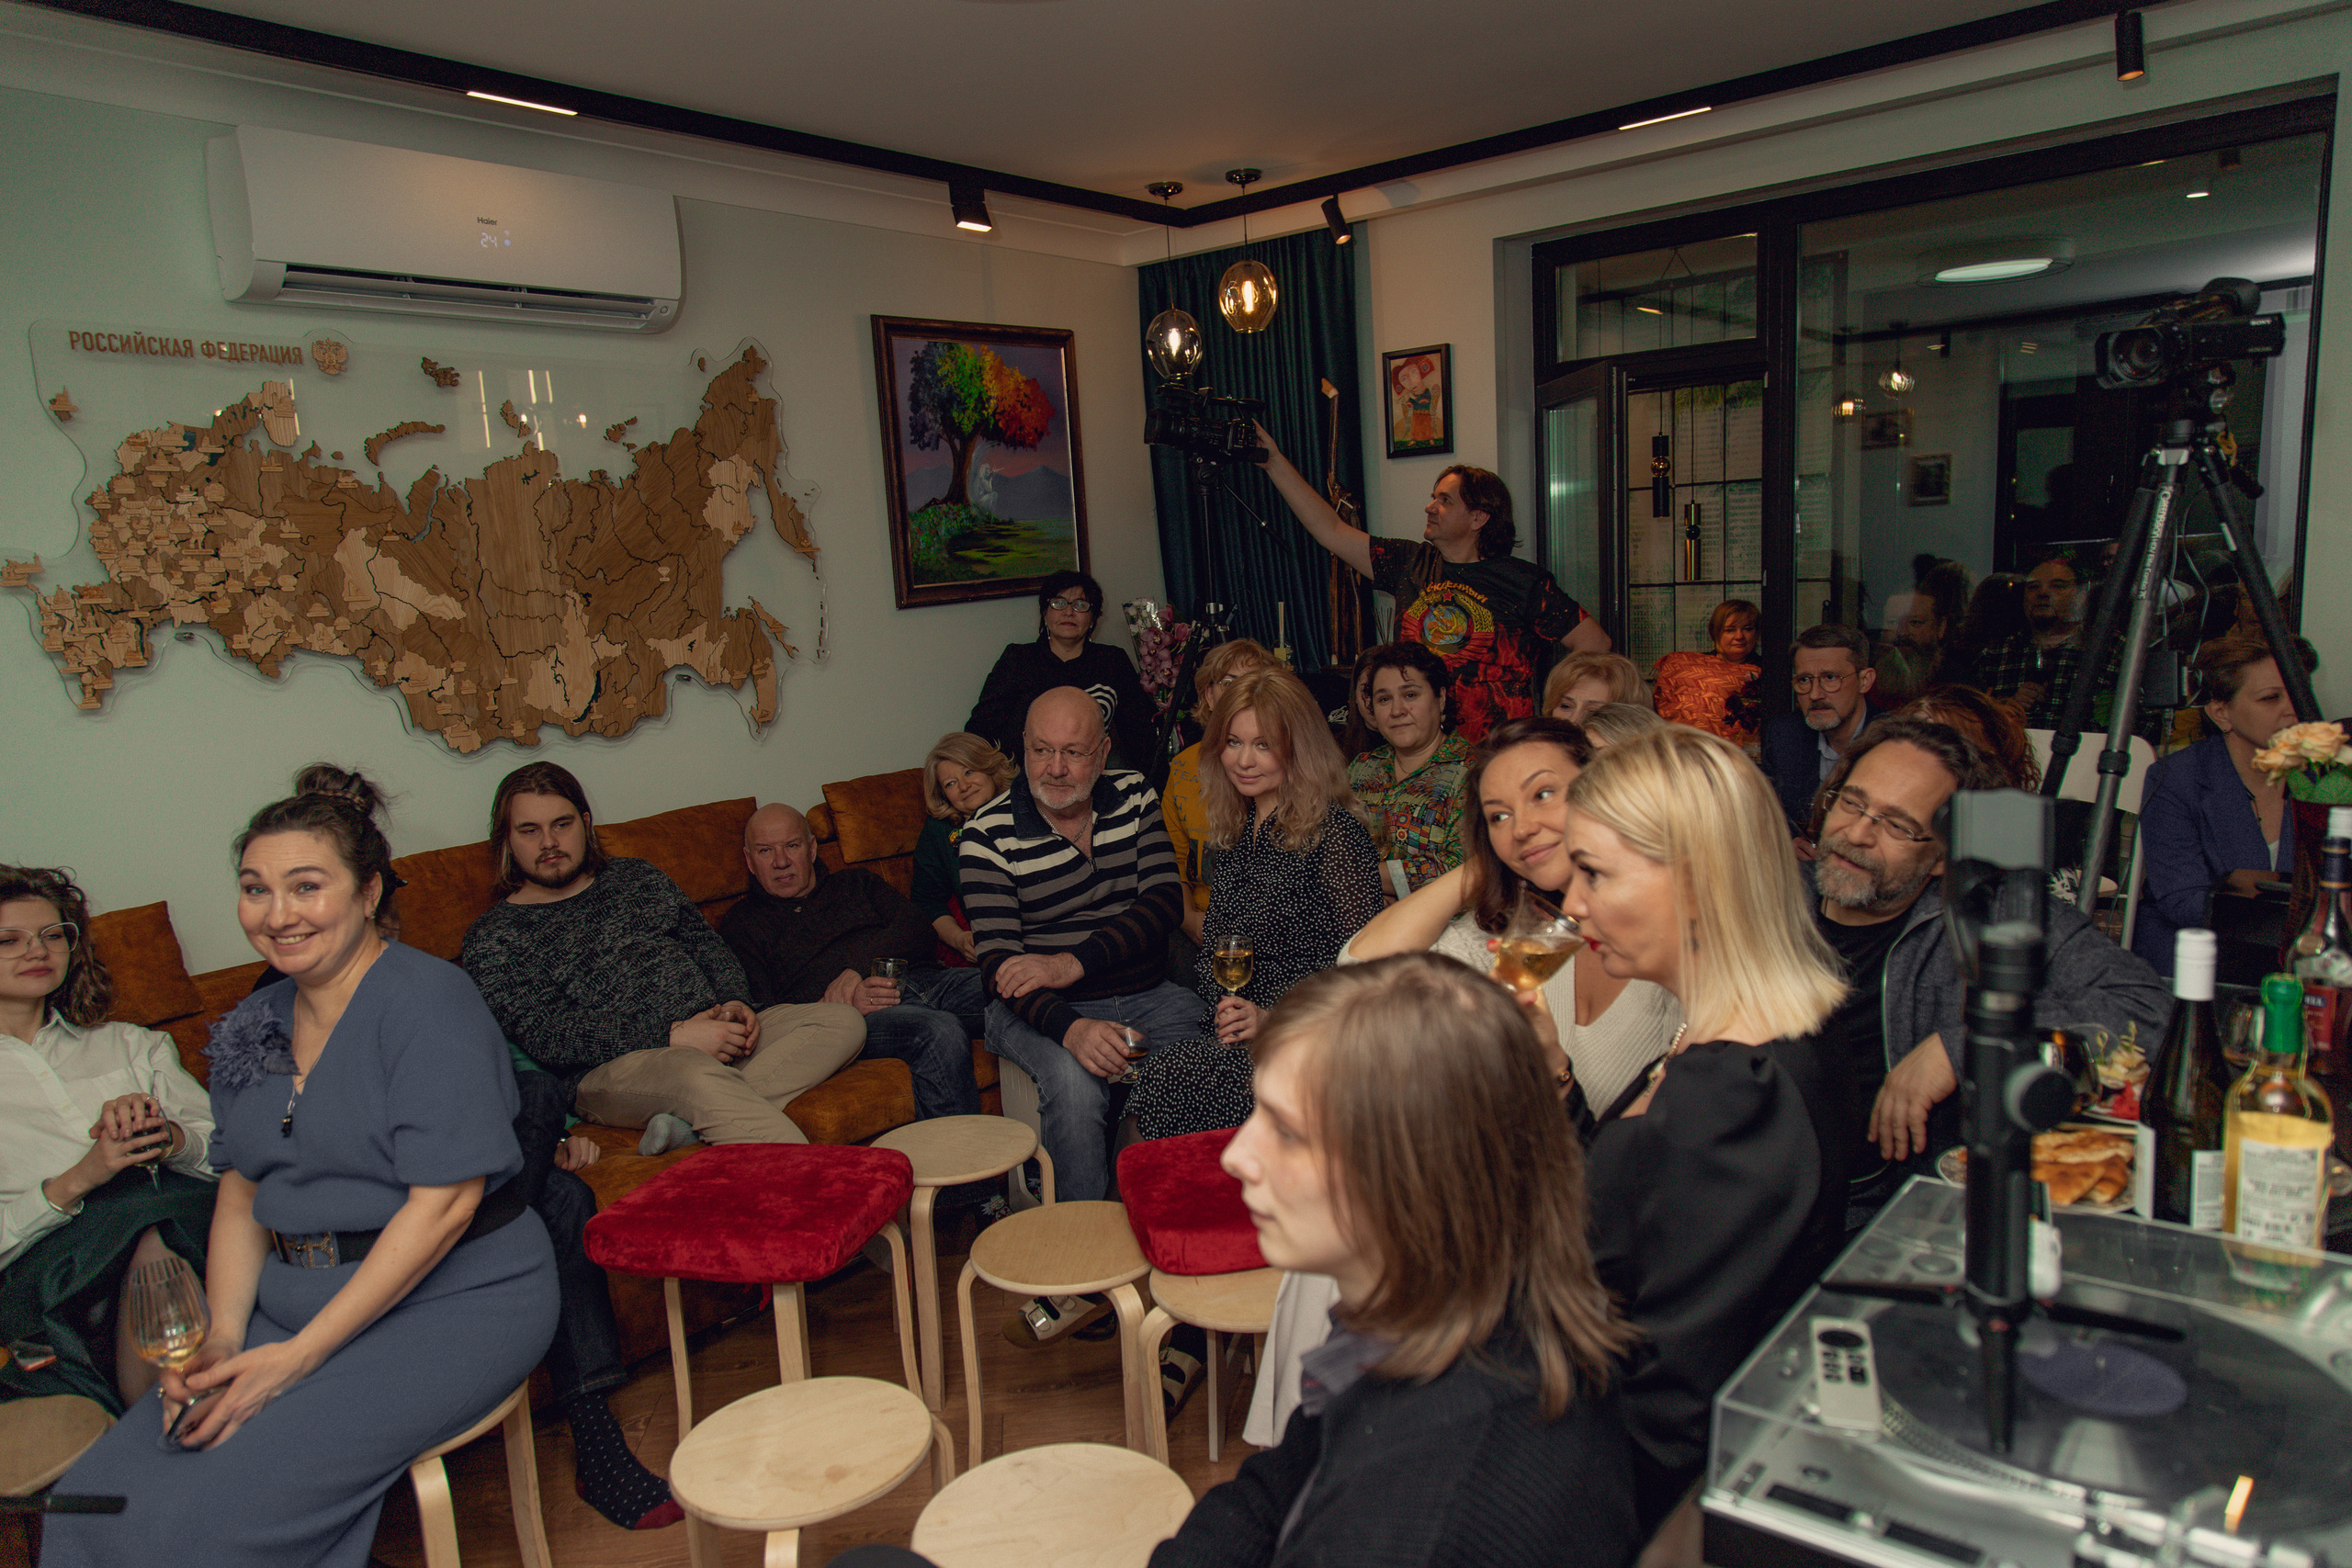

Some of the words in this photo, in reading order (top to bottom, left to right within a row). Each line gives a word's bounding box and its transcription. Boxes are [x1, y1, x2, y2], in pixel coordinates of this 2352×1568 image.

[477, 216, 498, 226] Haier
[481, 231, 497, 248] 24
[69, 331, 194, 358] РОССИЙСКАЯ
[200, 340, 304, 366] ФЕДЕРАЦИЯ
